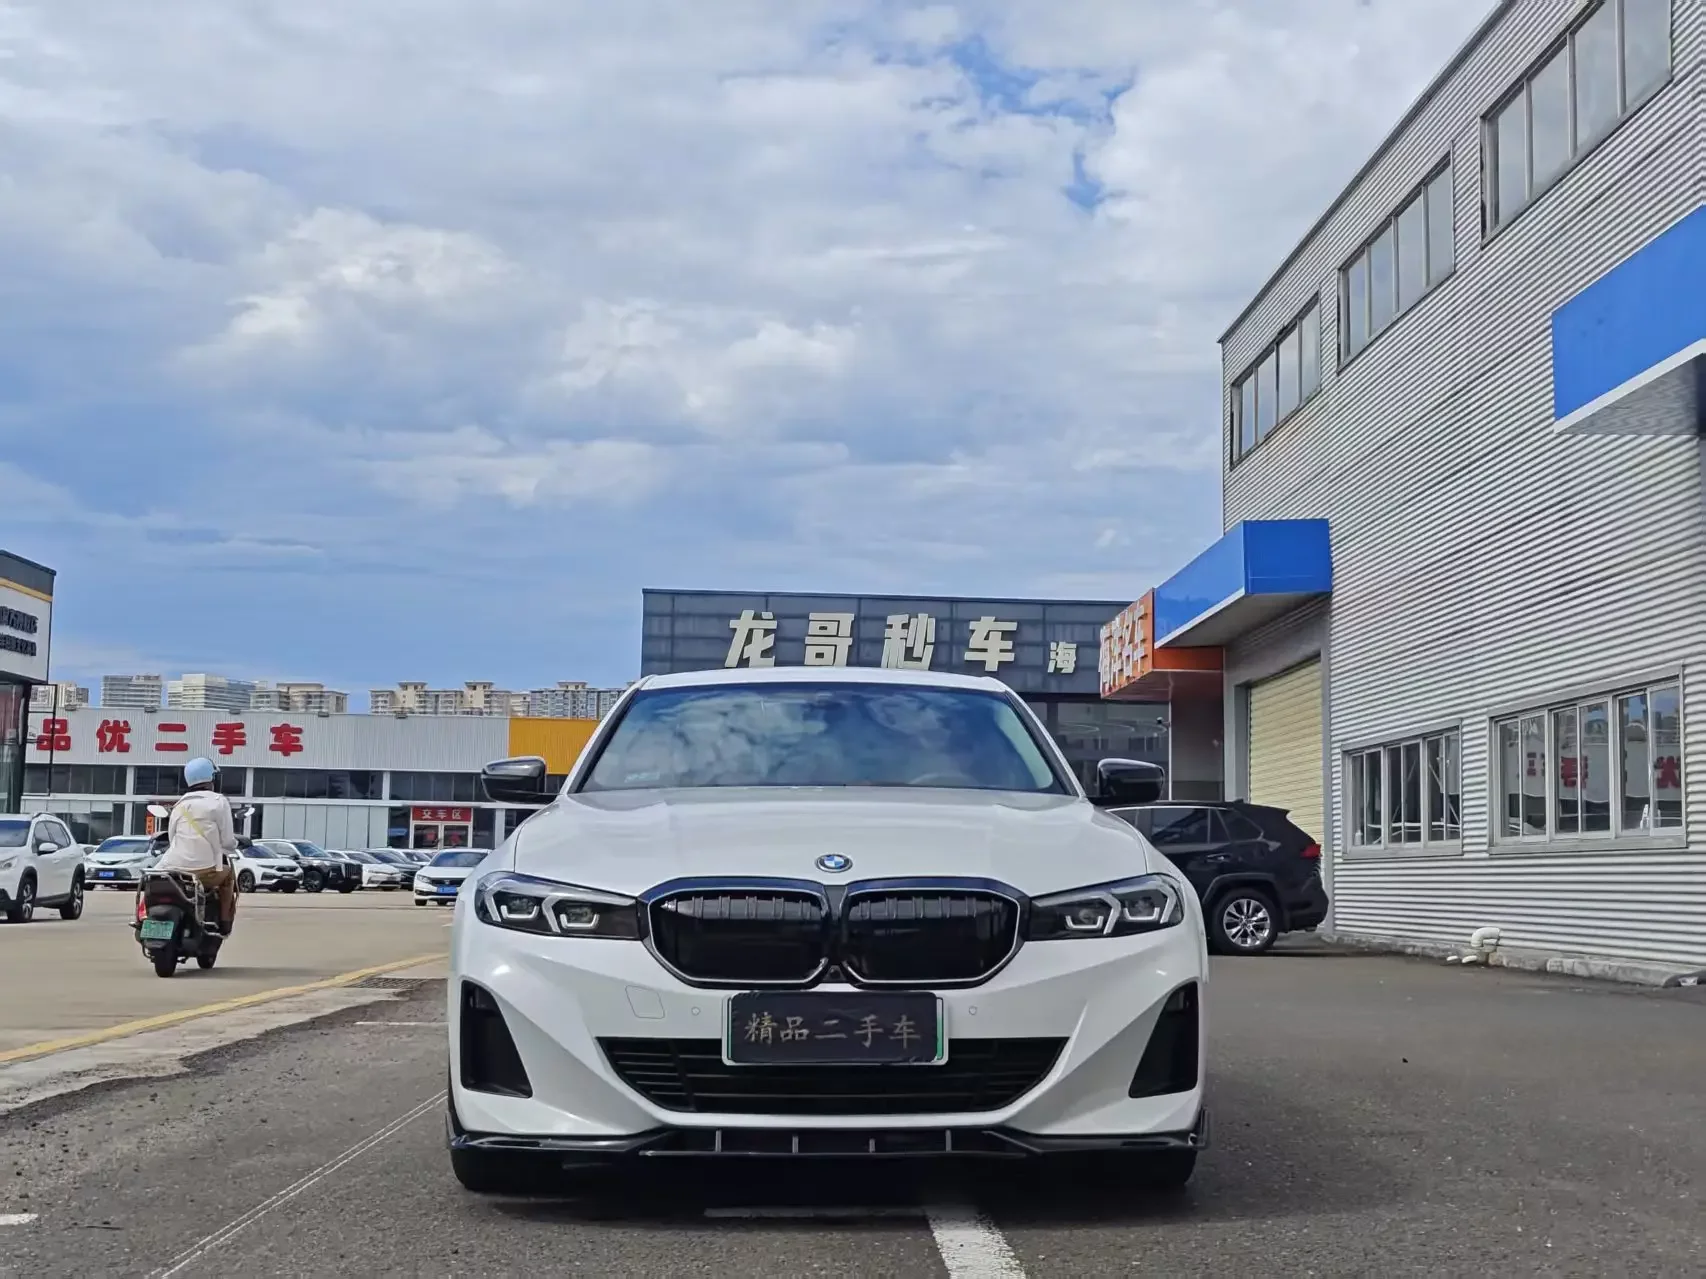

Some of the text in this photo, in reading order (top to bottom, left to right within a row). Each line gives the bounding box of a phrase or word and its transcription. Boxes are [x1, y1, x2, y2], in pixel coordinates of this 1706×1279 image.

[725, 610, 1017, 670] 龙哥秒车
[37, 718, 303, 756] 品优二手车
[744, 1011, 921, 1048] 精品二手车
